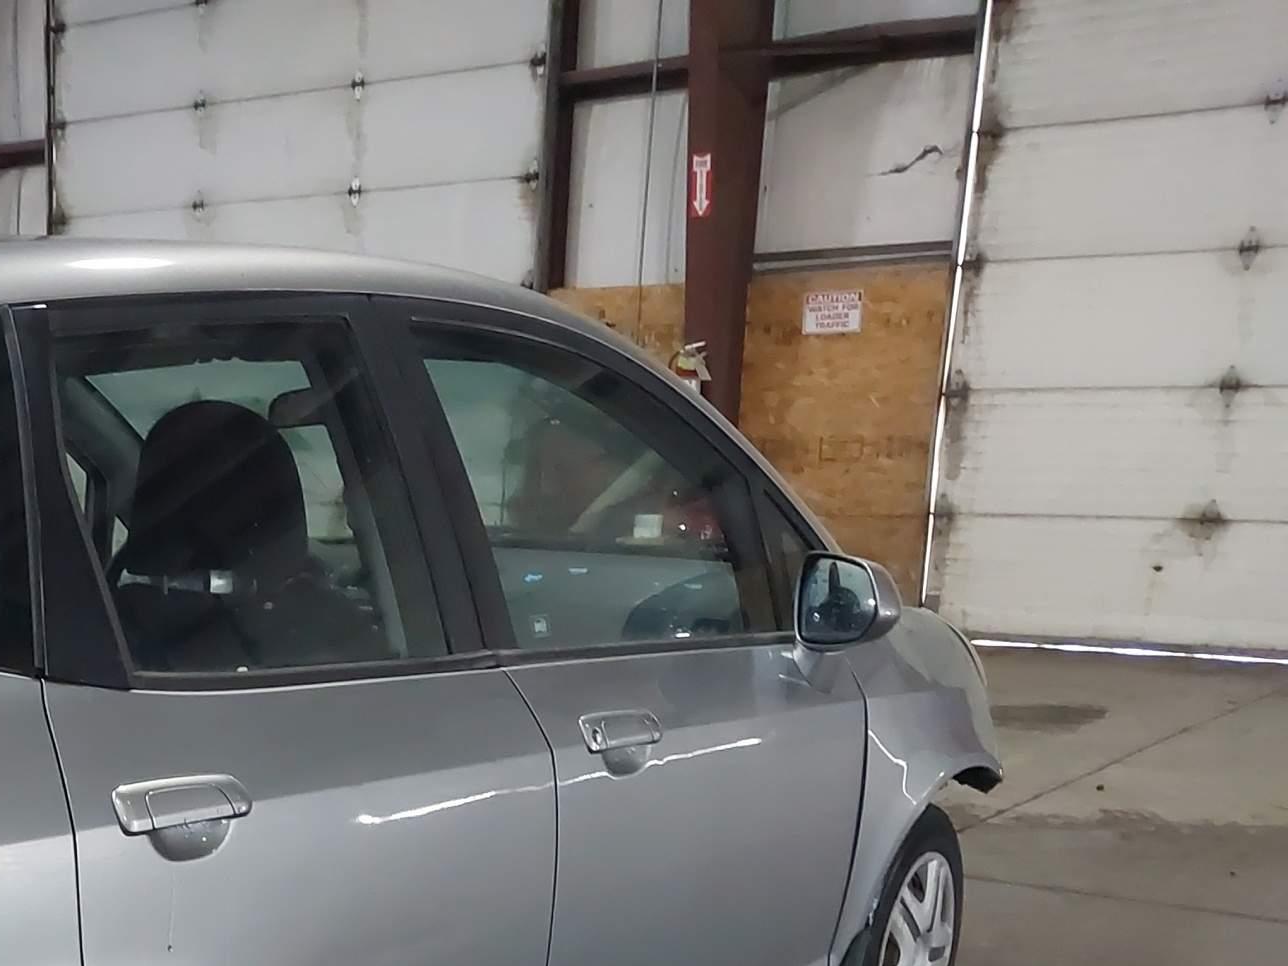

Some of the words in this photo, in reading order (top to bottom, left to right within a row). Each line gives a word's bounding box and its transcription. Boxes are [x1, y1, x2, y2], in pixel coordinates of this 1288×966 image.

[808, 293, 857, 304] CAUTION
[808, 304, 839, 312] WATCH
[842, 303, 859, 311] FOR
[815, 312, 849, 320] LOADER
[815, 320, 849, 329] TRAFFIC
